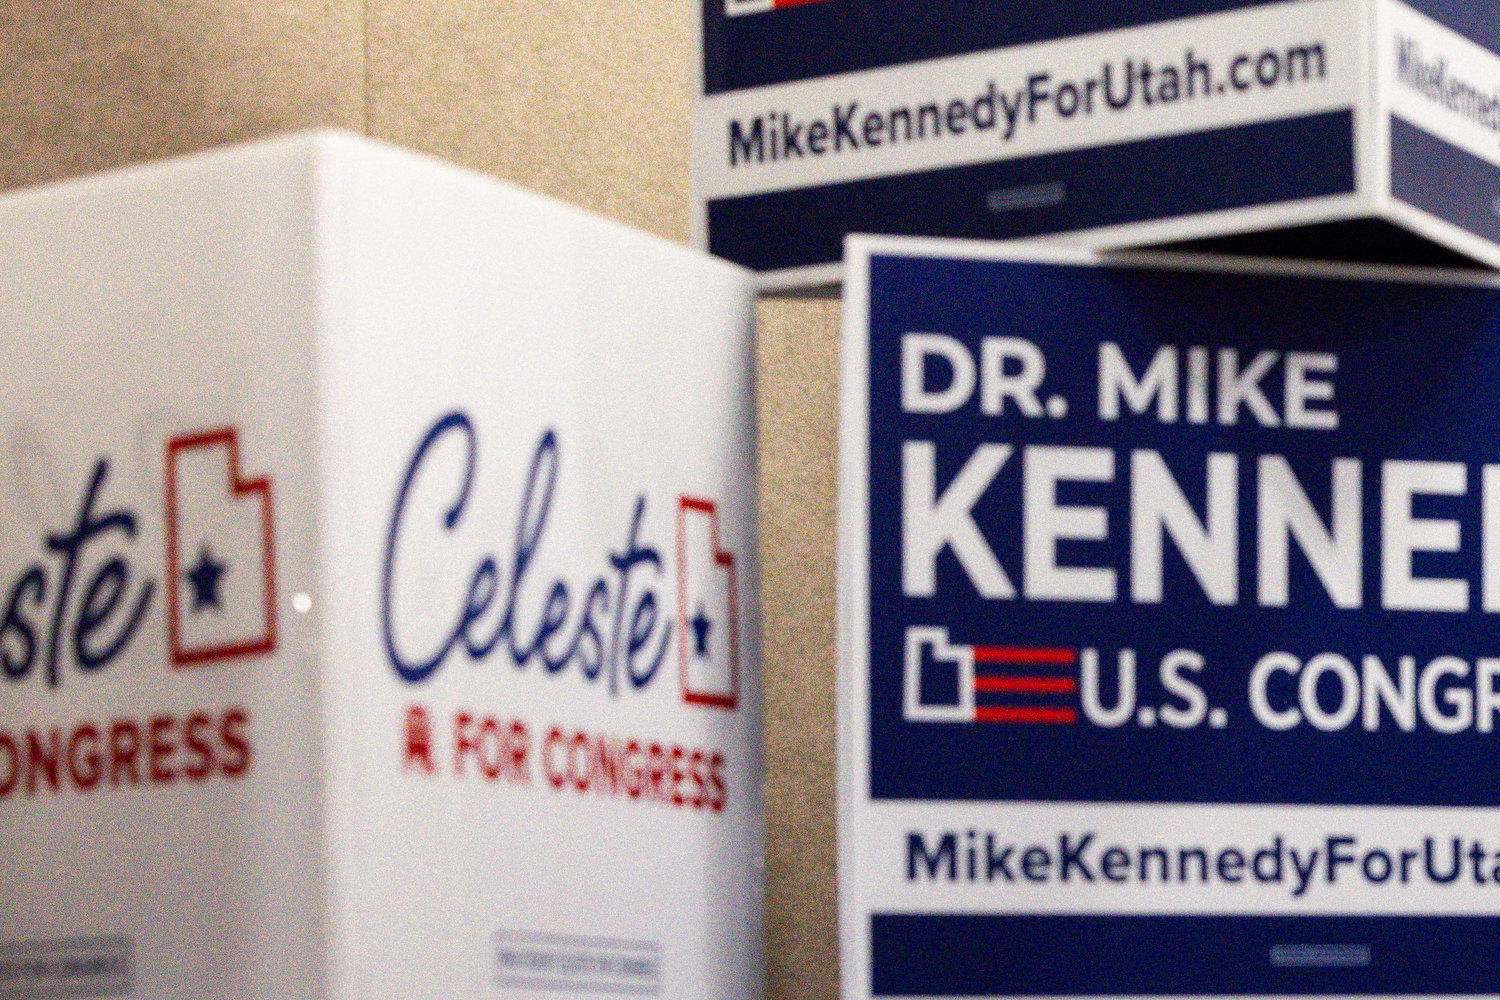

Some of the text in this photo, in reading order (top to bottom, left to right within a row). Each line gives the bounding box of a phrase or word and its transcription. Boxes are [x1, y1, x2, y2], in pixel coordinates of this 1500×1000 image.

[728, 38, 1327, 167] MikeKennedyForUtah.com
[900, 333, 1339, 429] DR. MIKE
[380, 411, 674, 696] Celeste
[1079, 648, 1228, 729] U.S.
[0, 709, 254, 797] ONGRESS
[453, 711, 728, 813] FOR CONGRESS
